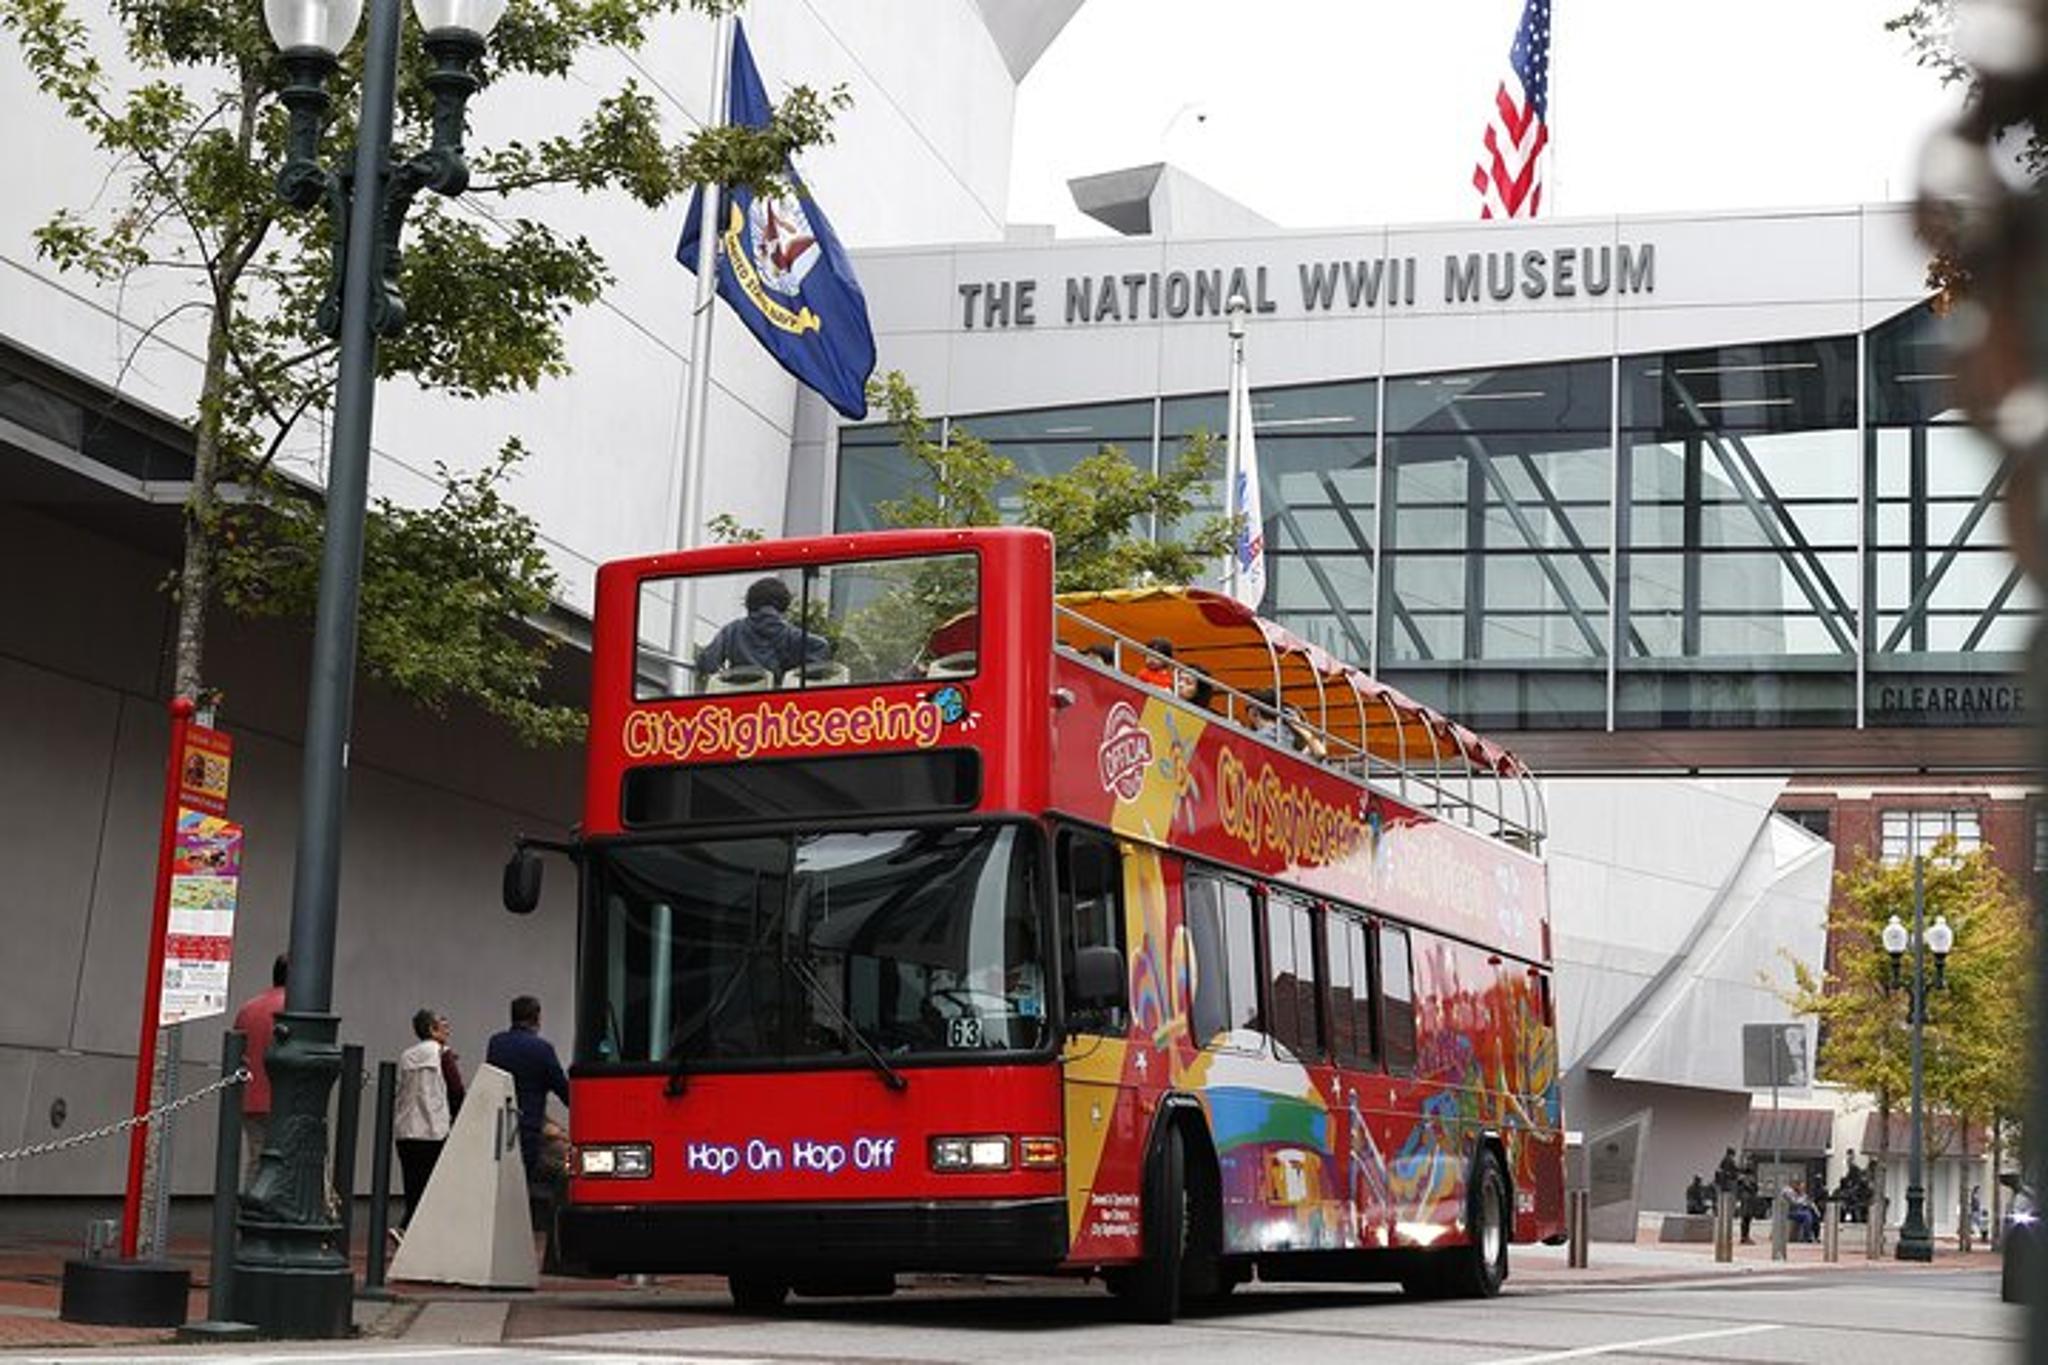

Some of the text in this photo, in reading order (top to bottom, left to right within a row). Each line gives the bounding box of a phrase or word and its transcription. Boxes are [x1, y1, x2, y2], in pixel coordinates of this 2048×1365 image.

[958, 244, 1654, 328] THE NATIONAL WWII MUSEUM
[1881, 687, 2025, 712] CLEARANCE
[623, 697, 942, 759] CitySightseeing
[952, 1019, 979, 1044] 63
[688, 1137, 895, 1174] Hop On Hop Off
